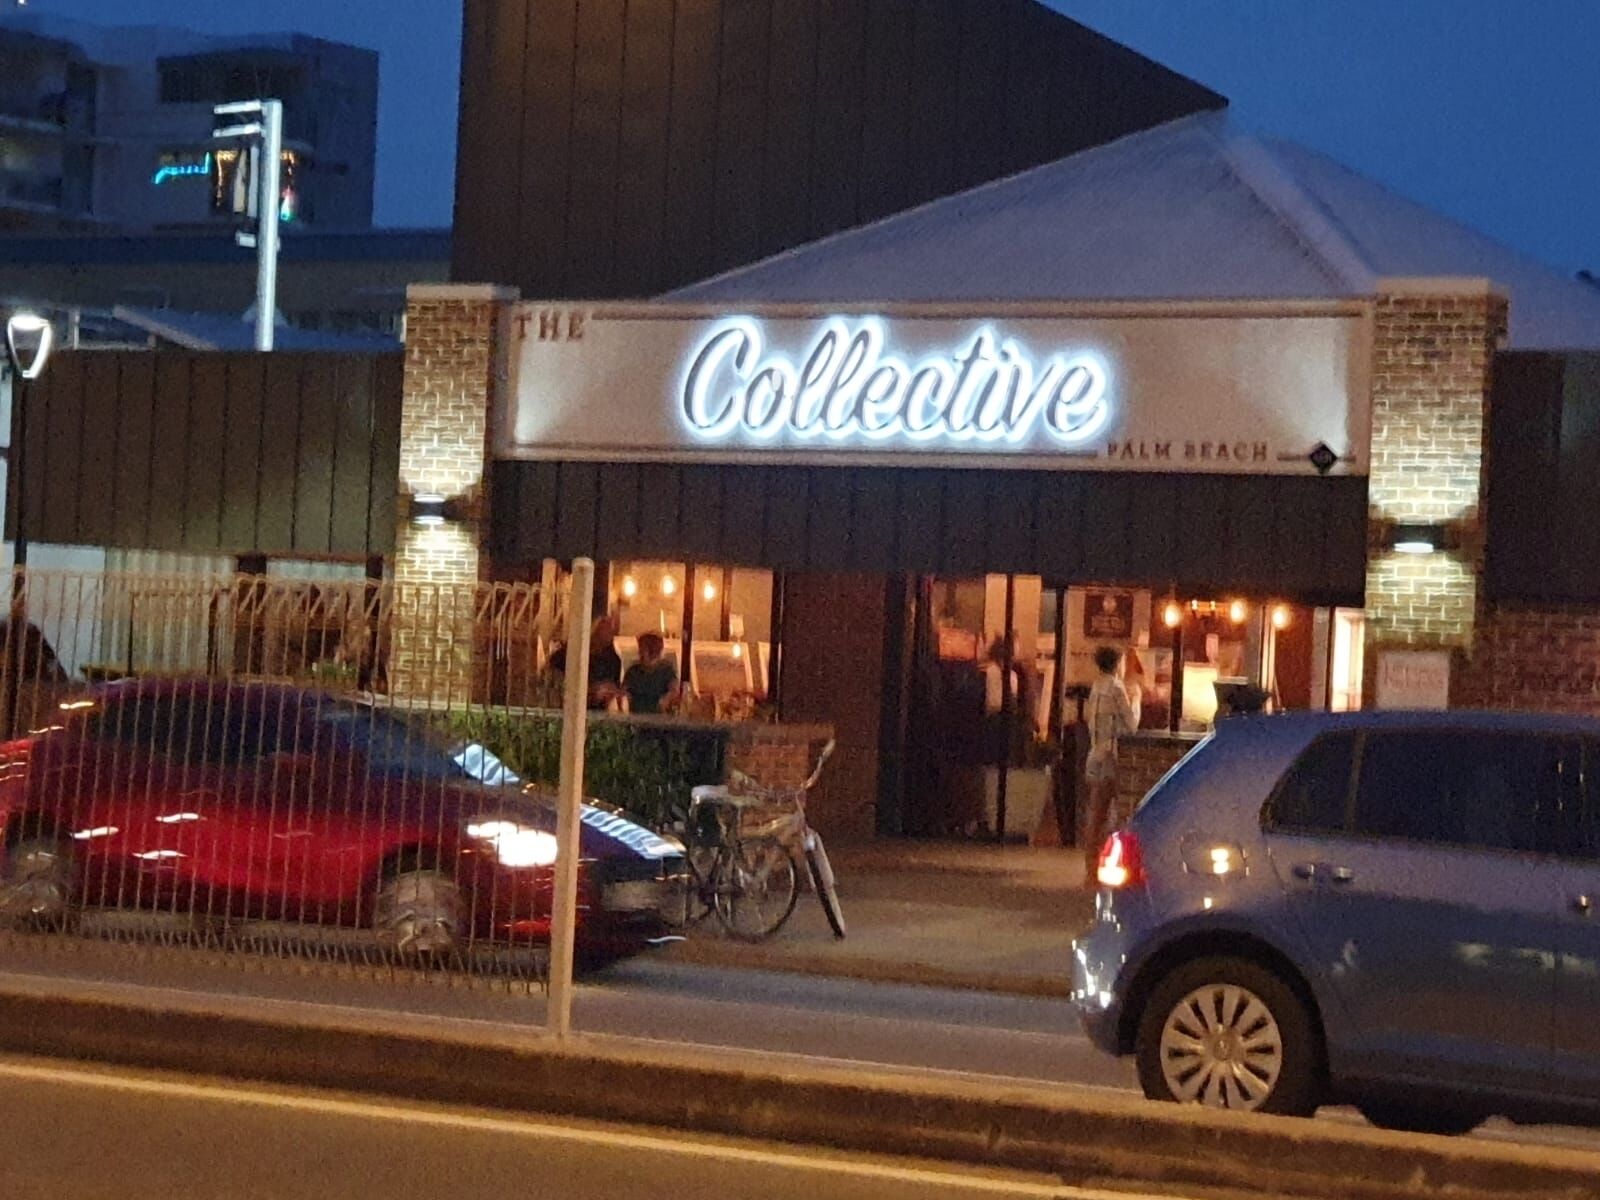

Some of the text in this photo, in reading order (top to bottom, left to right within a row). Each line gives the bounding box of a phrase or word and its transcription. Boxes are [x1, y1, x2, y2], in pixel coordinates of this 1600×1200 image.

[513, 311, 585, 340] THE
[682, 318, 1106, 440] Collective
[1107, 440, 1268, 461] PALM BEACH
